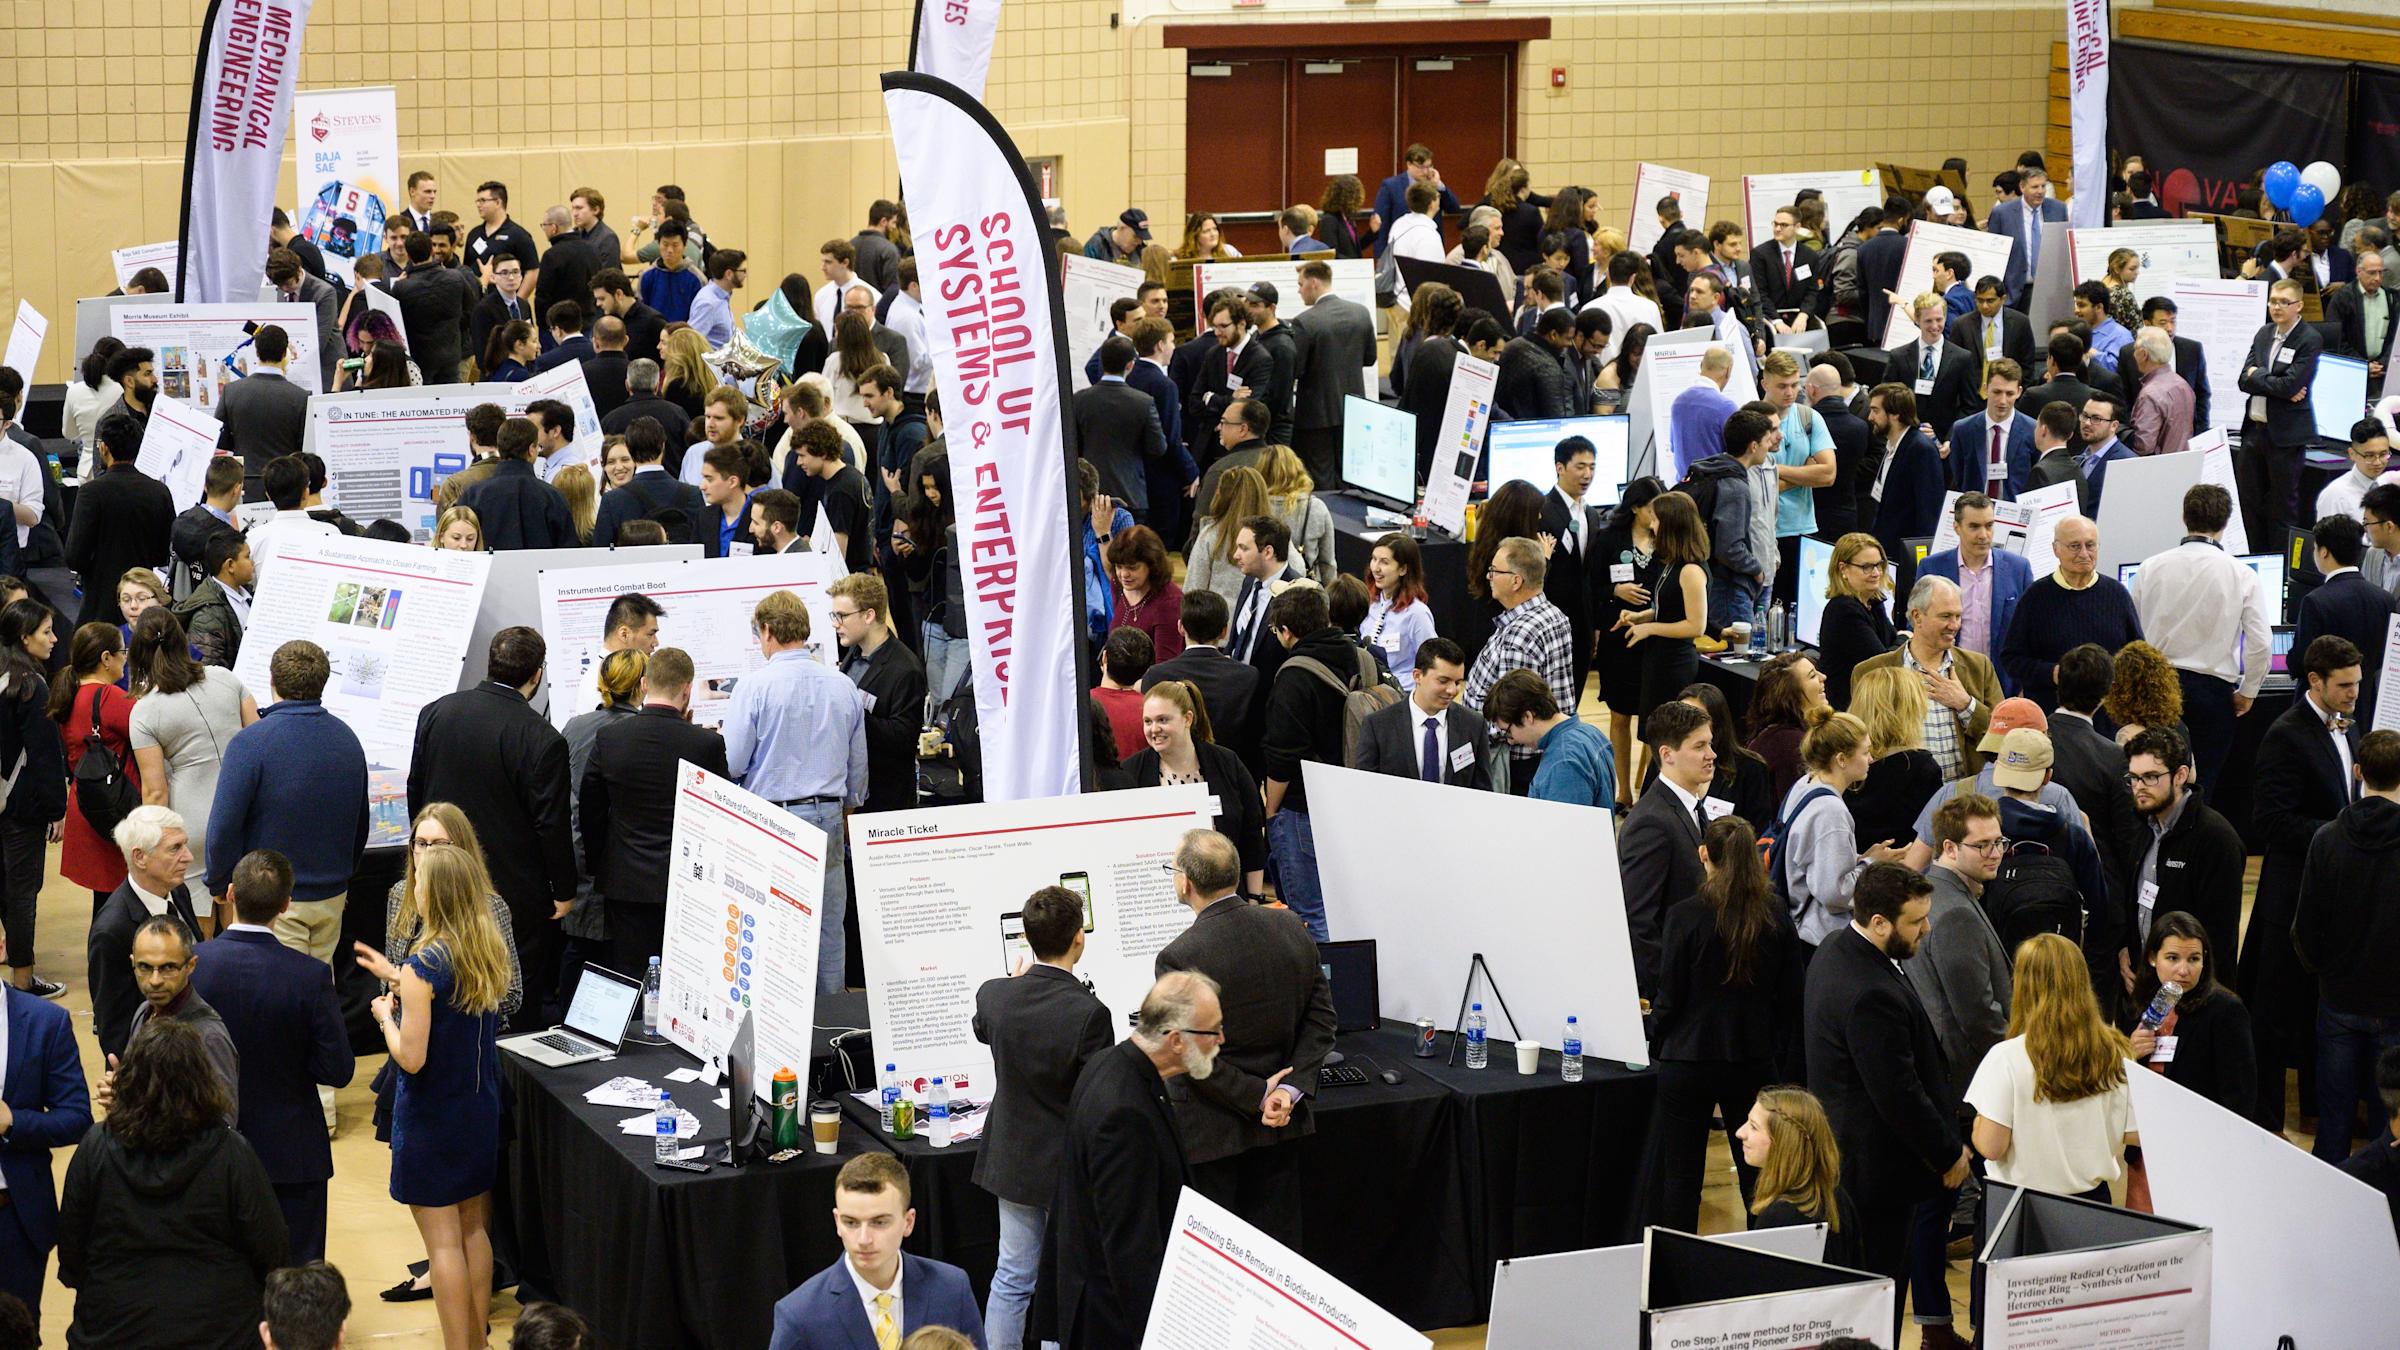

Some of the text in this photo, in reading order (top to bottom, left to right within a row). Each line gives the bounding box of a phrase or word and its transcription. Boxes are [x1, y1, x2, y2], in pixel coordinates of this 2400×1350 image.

[212, 0, 262, 152] ENGINEERING
[243, 5, 292, 149] MECHANICAL
[333, 115, 381, 126] STEVENS
[315, 152, 341, 162] BAJA
[316, 163, 335, 173] SAE
[345, 191, 359, 212] S
[980, 212, 1036, 377] SCHOOL
[354, 411, 380, 419] TUNE:
[381, 410, 398, 418] THE
[400, 408, 454, 417] AUTOMATED
[455, 408, 472, 416] PIAN
[934, 224, 1018, 722] SYSTEMS & ENTERPRI
[324, 550, 356, 562] Sustainable
[358, 554, 386, 566] Approach
[393, 559, 412, 568] Ocean
[413, 562, 438, 574] Farming
[558, 584, 612, 596] Instrumented
[614, 582, 645, 592] Combat
[714, 790, 722, 800] The
[722, 794, 738, 810] Future
[737, 802, 743, 811] of
[742, 804, 758, 821] Clinical
[759, 813, 769, 825] Trial
[769, 818, 796, 840] Management
[868, 824, 938, 838] Miracle Ticket
[1187, 1214, 1224, 1250] Optimizing
[1226, 1238, 1244, 1258] Base
[1244, 1250, 1276, 1279] Removal
[1276, 1268, 1283, 1282] in
[1284, 1274, 1318, 1307] Biodiesel
[1318, 1296, 1358, 1332] Production
[2007, 1274, 2068, 1288] Investigating
[2070, 1268, 2104, 1281] Radical
[2106, 1260, 2155, 1276] Cyclization
[2170, 1256, 2184, 1266] the
[2007, 1288, 2046, 1300] Pyridine
[2049, 1284, 2070, 1295] Ring
[2080, 1276, 2122, 1291] Synthesis
[2124, 1274, 2134, 1284] of
[2136, 1270, 2160, 1282] Novel
[2007, 1298, 2064, 1312] Heterocycles
[1670, 1338, 1692, 1349] One
[1694, 1335, 1720, 1347] Step:
[1722, 1334, 1728, 1342] A
[1730, 1332, 1751, 1341] new
[1754, 1325, 1790, 1338] method
[1793, 1322, 1806, 1332] for
[1809, 1319, 1832, 1331] Drug
[1752, 1336, 1790, 1348] Pioneer
[1792, 1332, 1813, 1342] SPR
[1815, 1326, 1854, 1342] systems
[2100, 1328, 2132, 1337] METHODS
